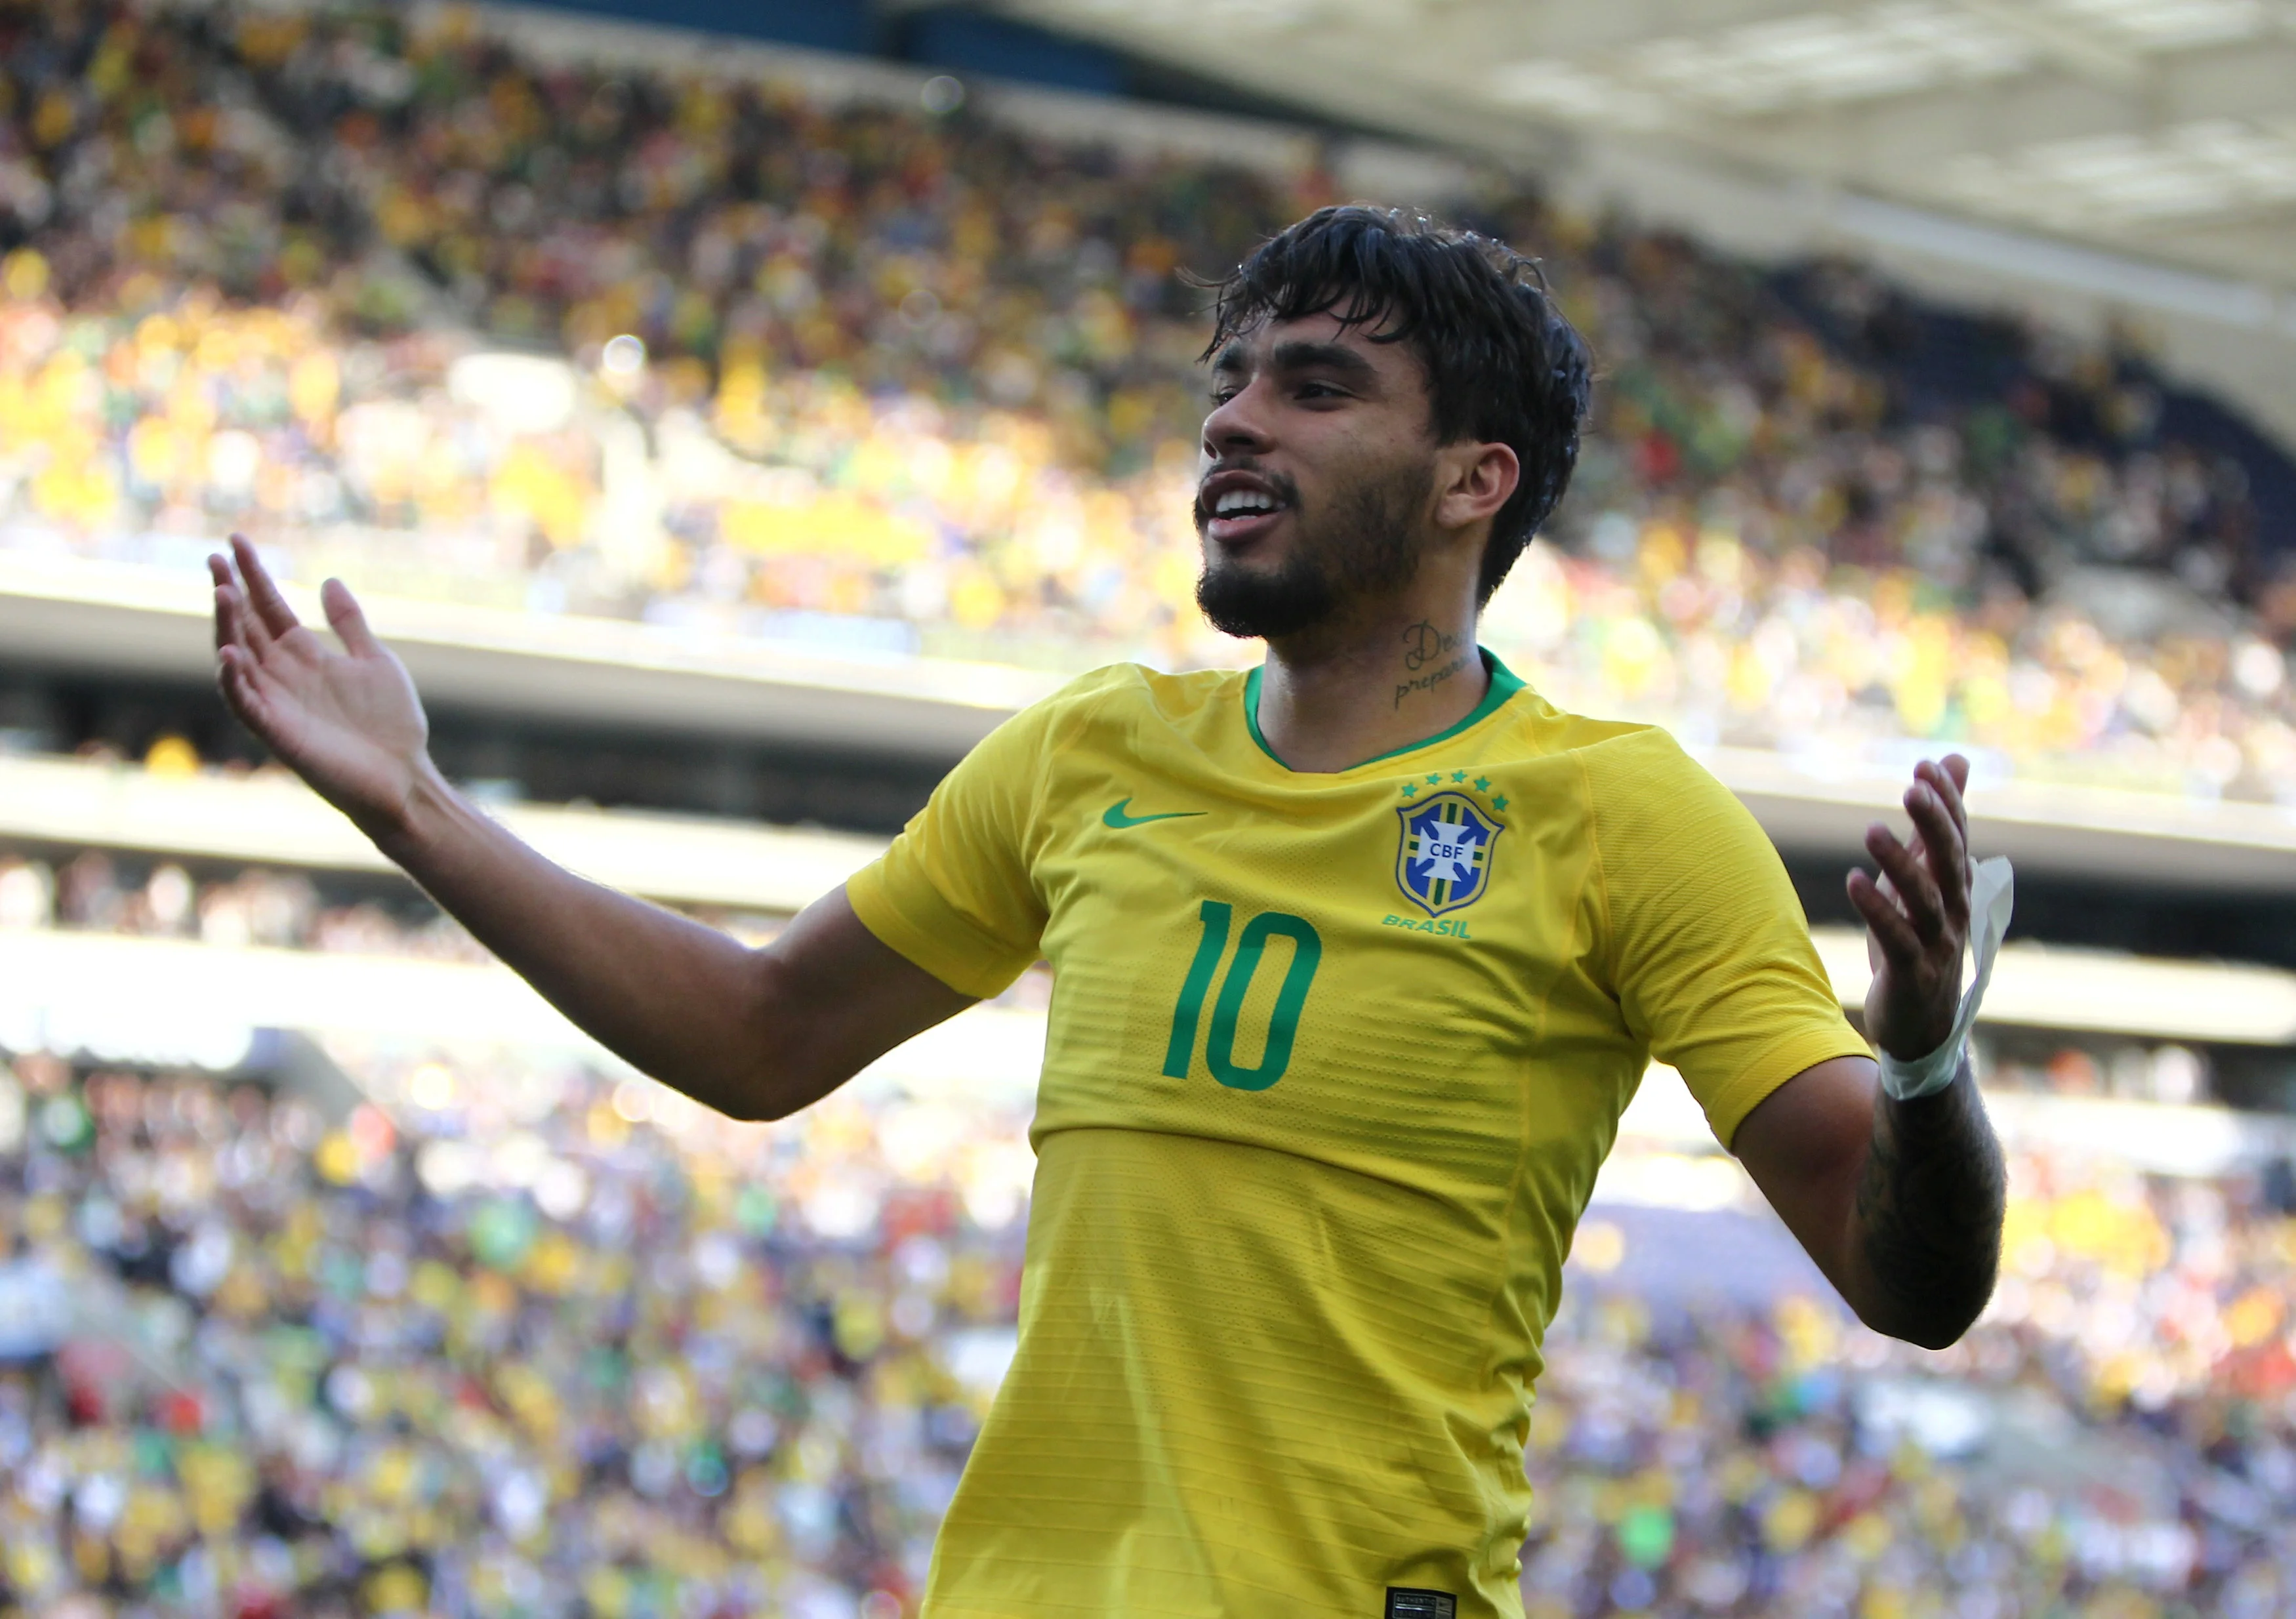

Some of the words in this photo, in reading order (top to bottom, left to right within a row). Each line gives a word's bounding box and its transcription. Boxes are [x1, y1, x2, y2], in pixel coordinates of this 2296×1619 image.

[1430, 843, 1464, 859] CBF
[1382, 914, 1471, 939] BRASIL
[1162, 899, 1322, 1092] 10
